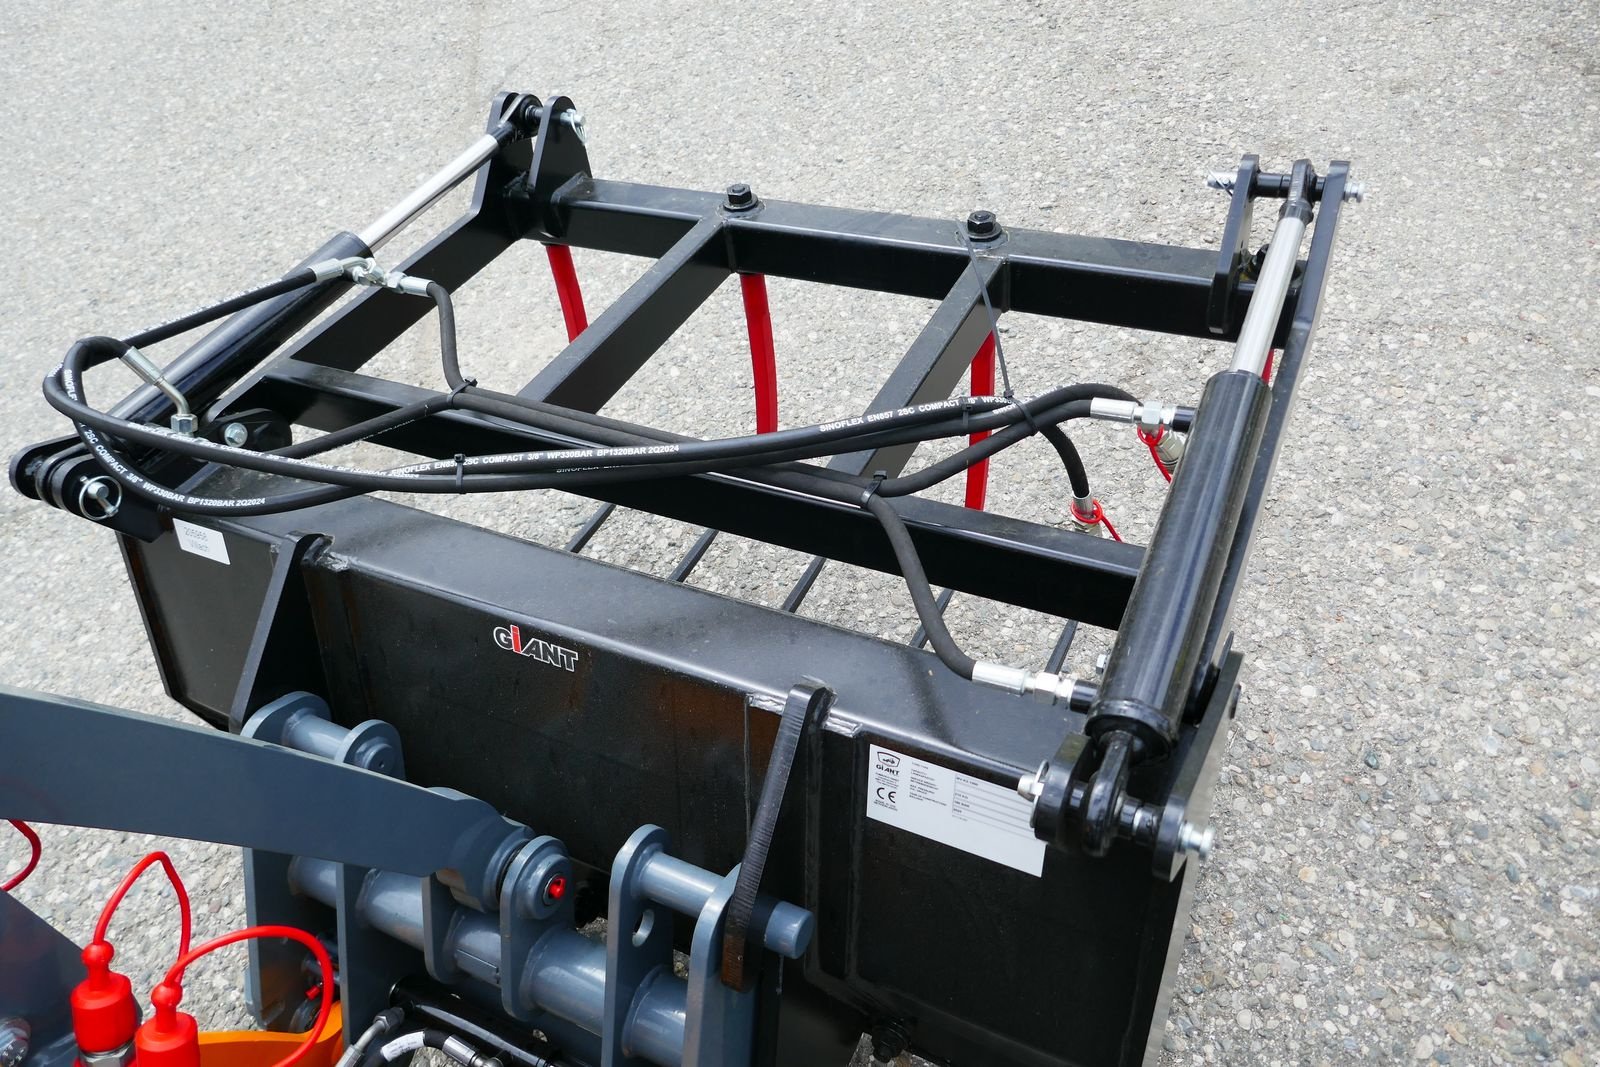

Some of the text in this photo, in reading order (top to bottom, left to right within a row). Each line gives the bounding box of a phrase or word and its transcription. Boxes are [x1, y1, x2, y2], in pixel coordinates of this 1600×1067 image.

[820, 416, 864, 432] SINOFLEX
[898, 407, 915, 416] 2SC
[919, 399, 960, 412] COMPACT
[84, 429, 99, 444] 2SC
[95, 444, 128, 474] COMPACT
[142, 481, 185, 502] WP330BAR
[187, 497, 235, 507] BP1320BAR
[235, 497, 266, 507] 2Q2024
[482, 454, 524, 464] COMPACT
[547, 450, 592, 459] WP330BAR
[596, 446, 647, 457] BP1320BAR
[647, 444, 680, 454] 2Q2024
[493, 624, 579, 672] GIANT
